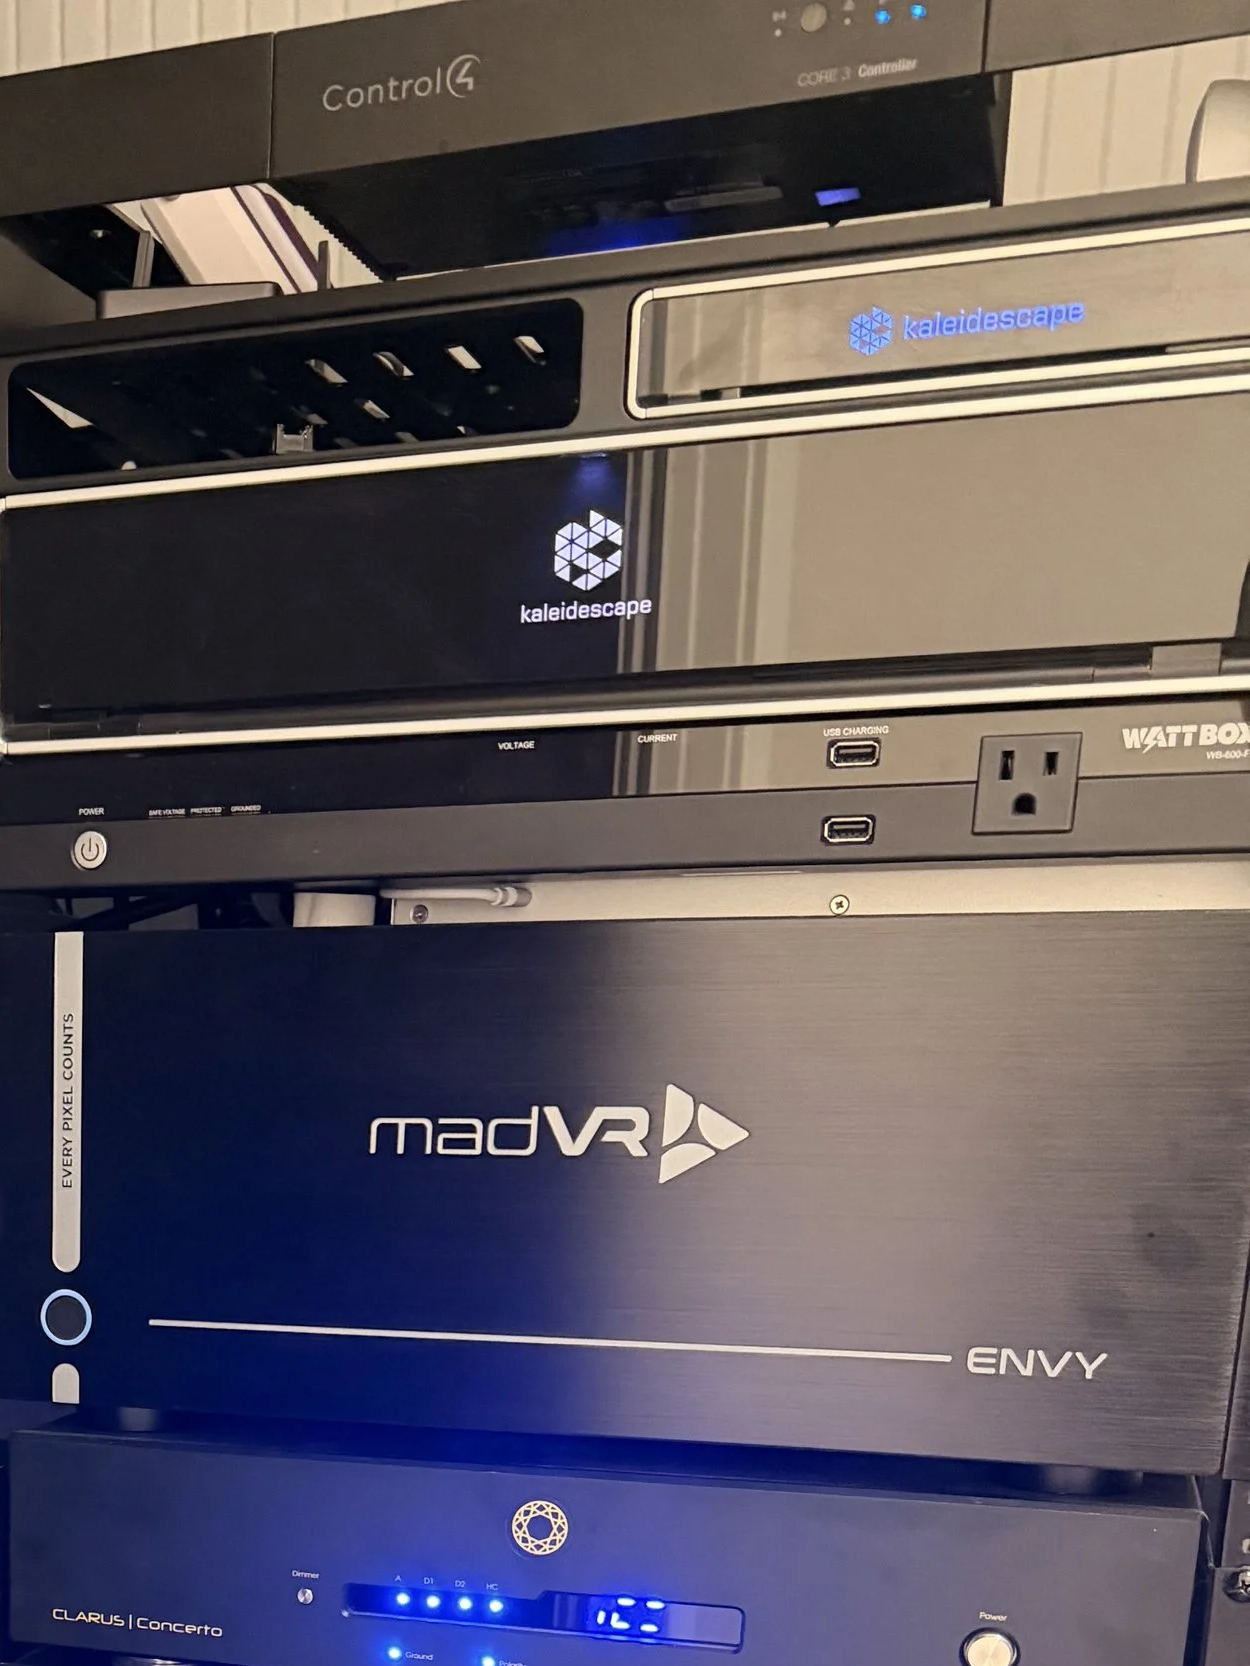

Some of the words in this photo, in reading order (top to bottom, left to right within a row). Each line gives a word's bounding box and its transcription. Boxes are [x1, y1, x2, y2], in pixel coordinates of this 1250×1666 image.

[858, 58, 919, 78] Controller
[903, 302, 1085, 340] kaleidescape
[520, 599, 652, 624] kaleidescape
[823, 728, 841, 737] USB
[842, 725, 890, 736] CHARGING
[637, 733, 678, 744] CURRENT
[498, 740, 535, 750] VOLTAGE
[78, 807, 105, 816] POWER
[190, 806, 222, 814] PROTECTED
[230, 804, 261, 813] GROUNDED
[62, 1013, 74, 1081] COUNTS
[62, 1085, 74, 1131] PIXEL
[368, 1105, 650, 1158] madVR
[61, 1136, 73, 1189] EVERY
[966, 1346, 1108, 1380] ENVY
[292, 1570, 319, 1579] Dimmer
[424, 1577, 434, 1585] D1
[455, 1580, 466, 1588] D2
[978, 1611, 1007, 1621] Power
[52, 1608, 125, 1627] CLARUS
[136, 1617, 223, 1637] Concerto
[405, 1651, 434, 1661] Ground
